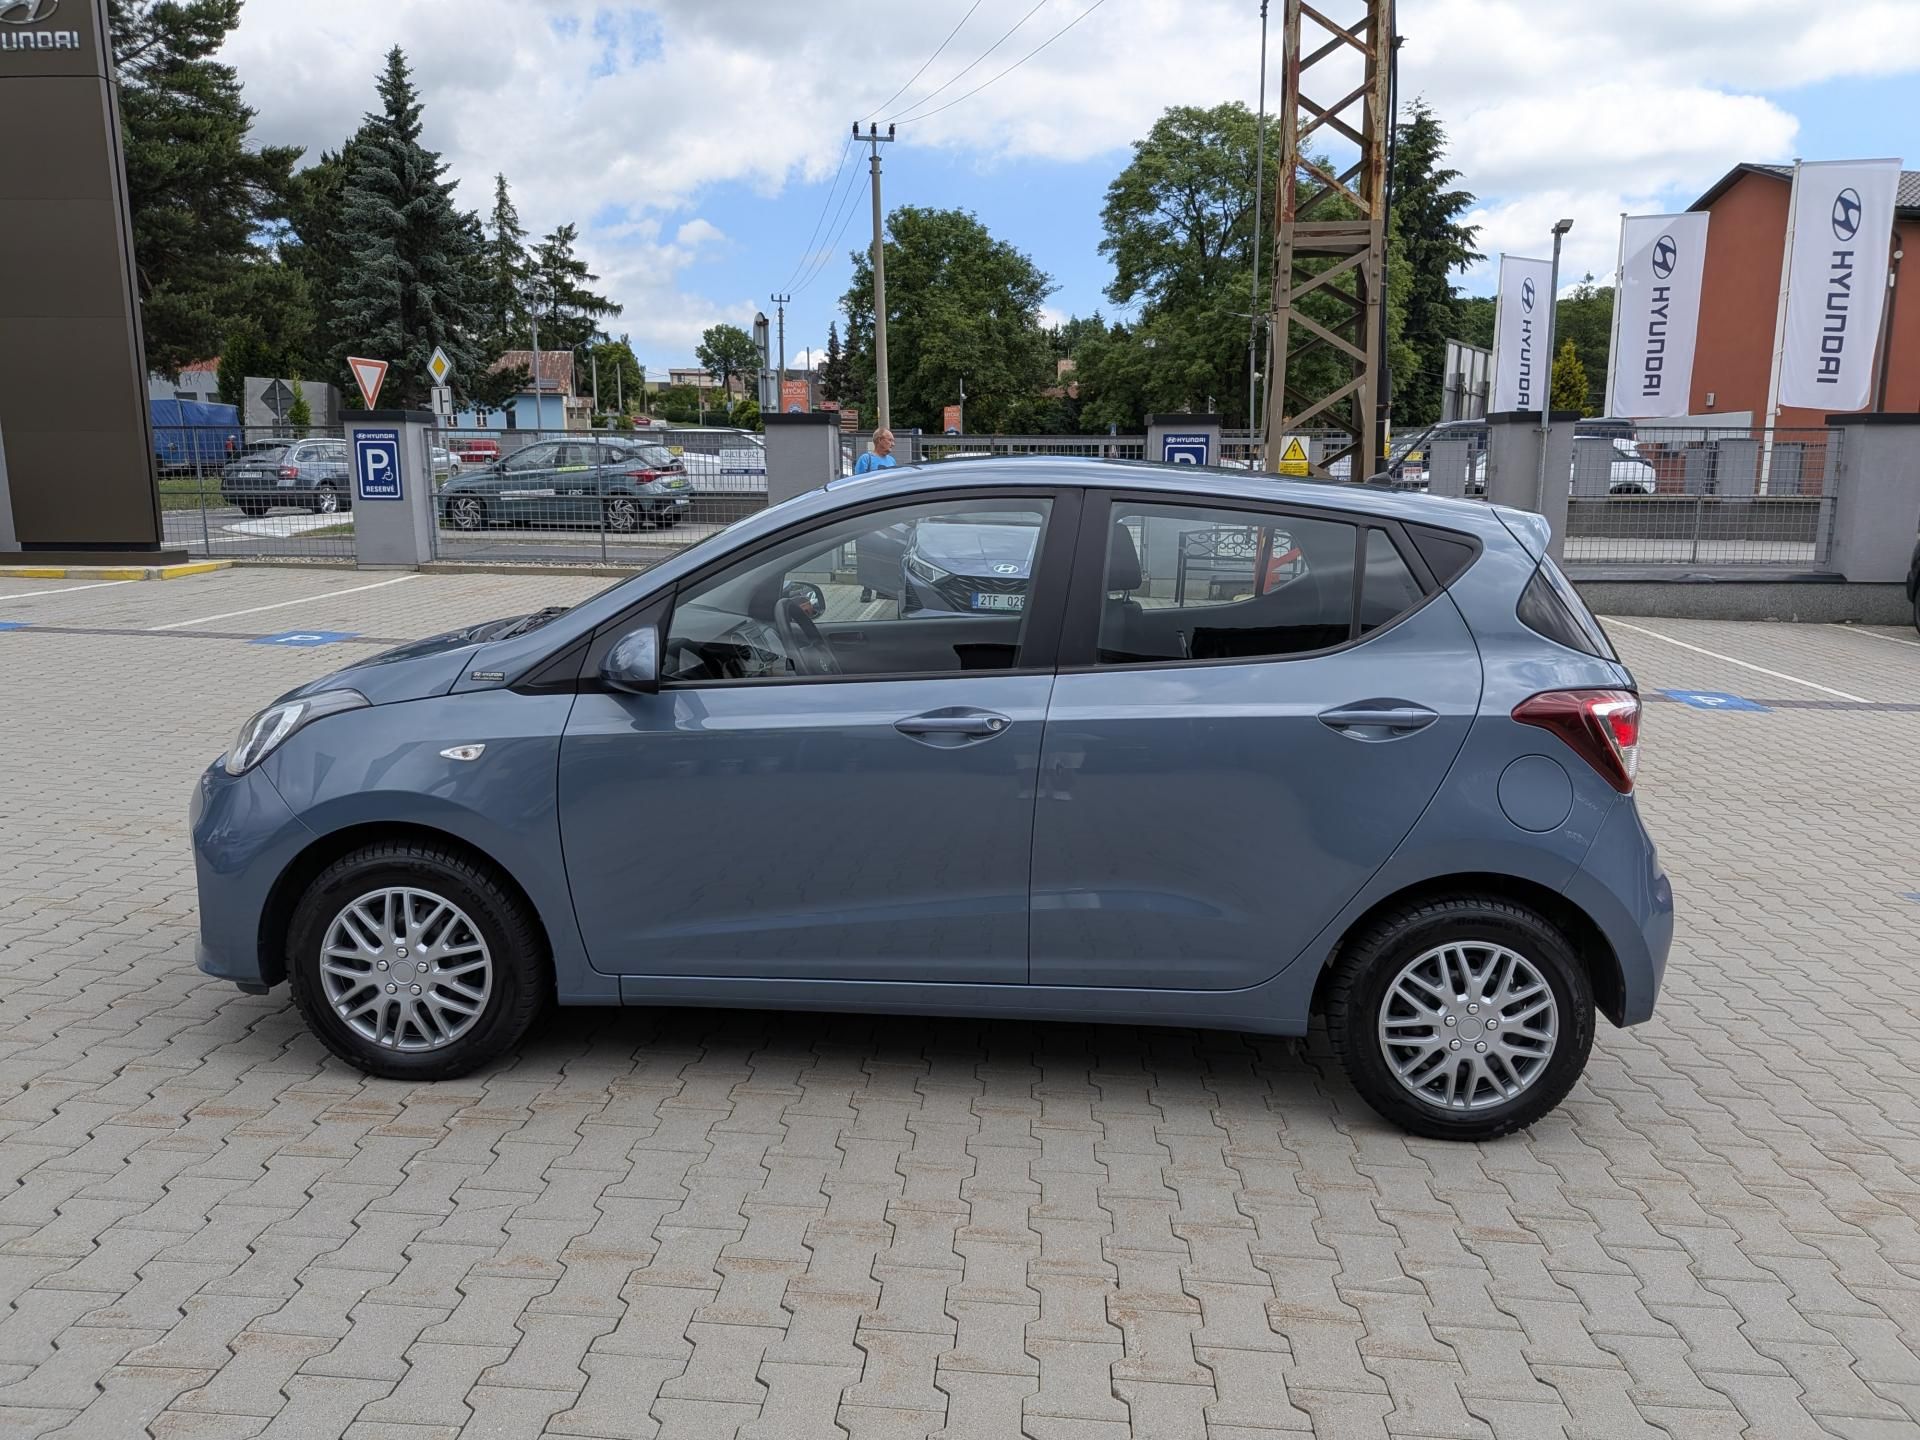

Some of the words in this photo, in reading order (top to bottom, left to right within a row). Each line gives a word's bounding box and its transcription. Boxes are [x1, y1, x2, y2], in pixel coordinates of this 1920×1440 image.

[1642, 286, 1671, 396] HYUNDAI
[1816, 250, 1854, 384] HYUNDAI
[1516, 319, 1532, 412] HYUNDAI
[366, 448, 389, 481] P
[366, 484, 396, 493] RESERVÉ
[980, 595, 999, 606] 2TF
